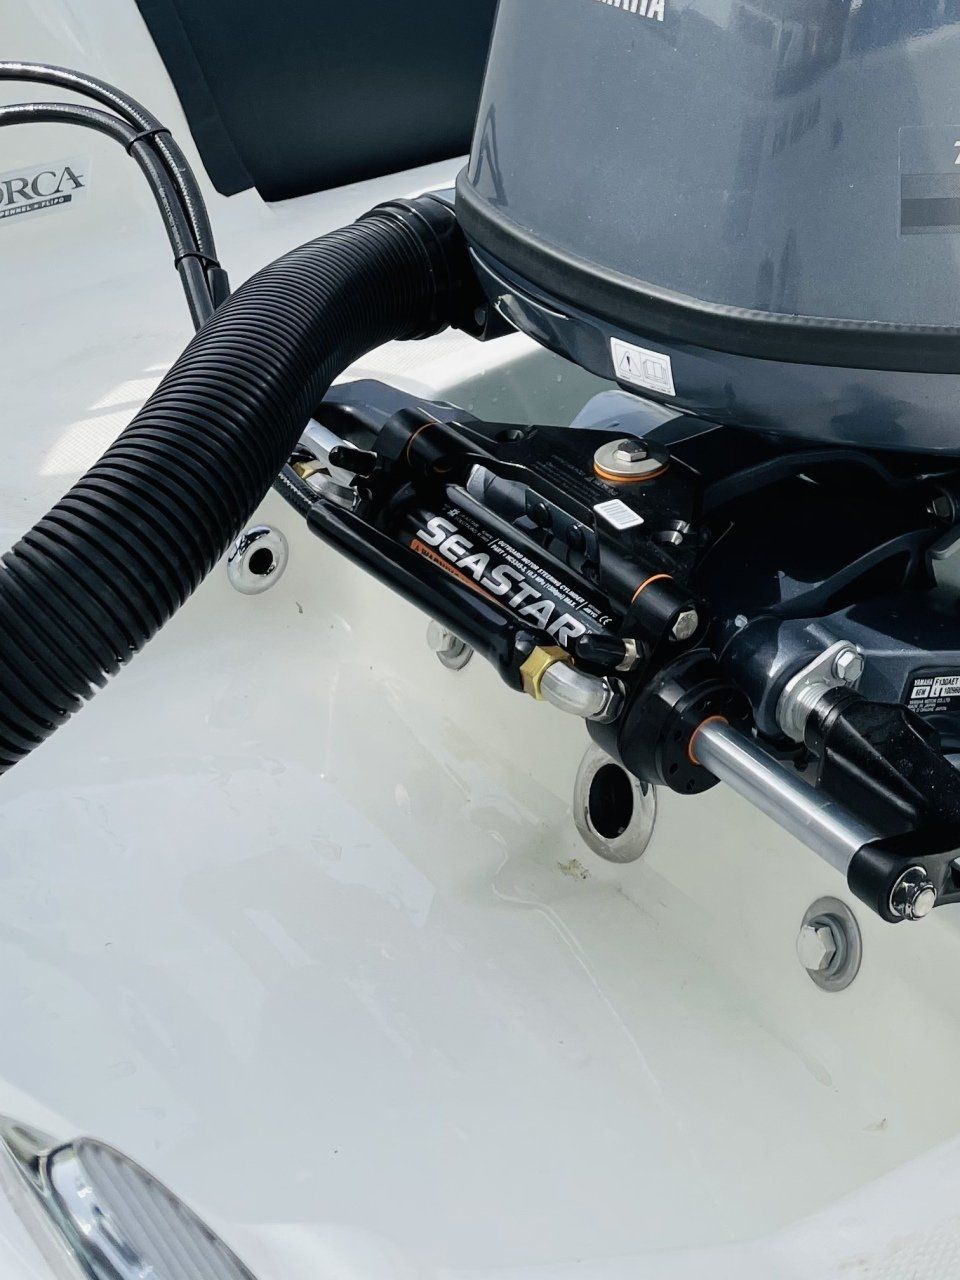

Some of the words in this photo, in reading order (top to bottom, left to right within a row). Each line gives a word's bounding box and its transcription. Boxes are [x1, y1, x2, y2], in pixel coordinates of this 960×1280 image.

[0, 166, 85, 206] RCA
[490, 544, 503, 554] PART
[415, 516, 587, 648] SEASTAR
[497, 540, 523, 558] OUTBOARD
[520, 556, 539, 570] MOTOR
[536, 568, 562, 587] STEERING
[558, 584, 585, 603] CYLINDER
[934, 687, 937, 695] L
